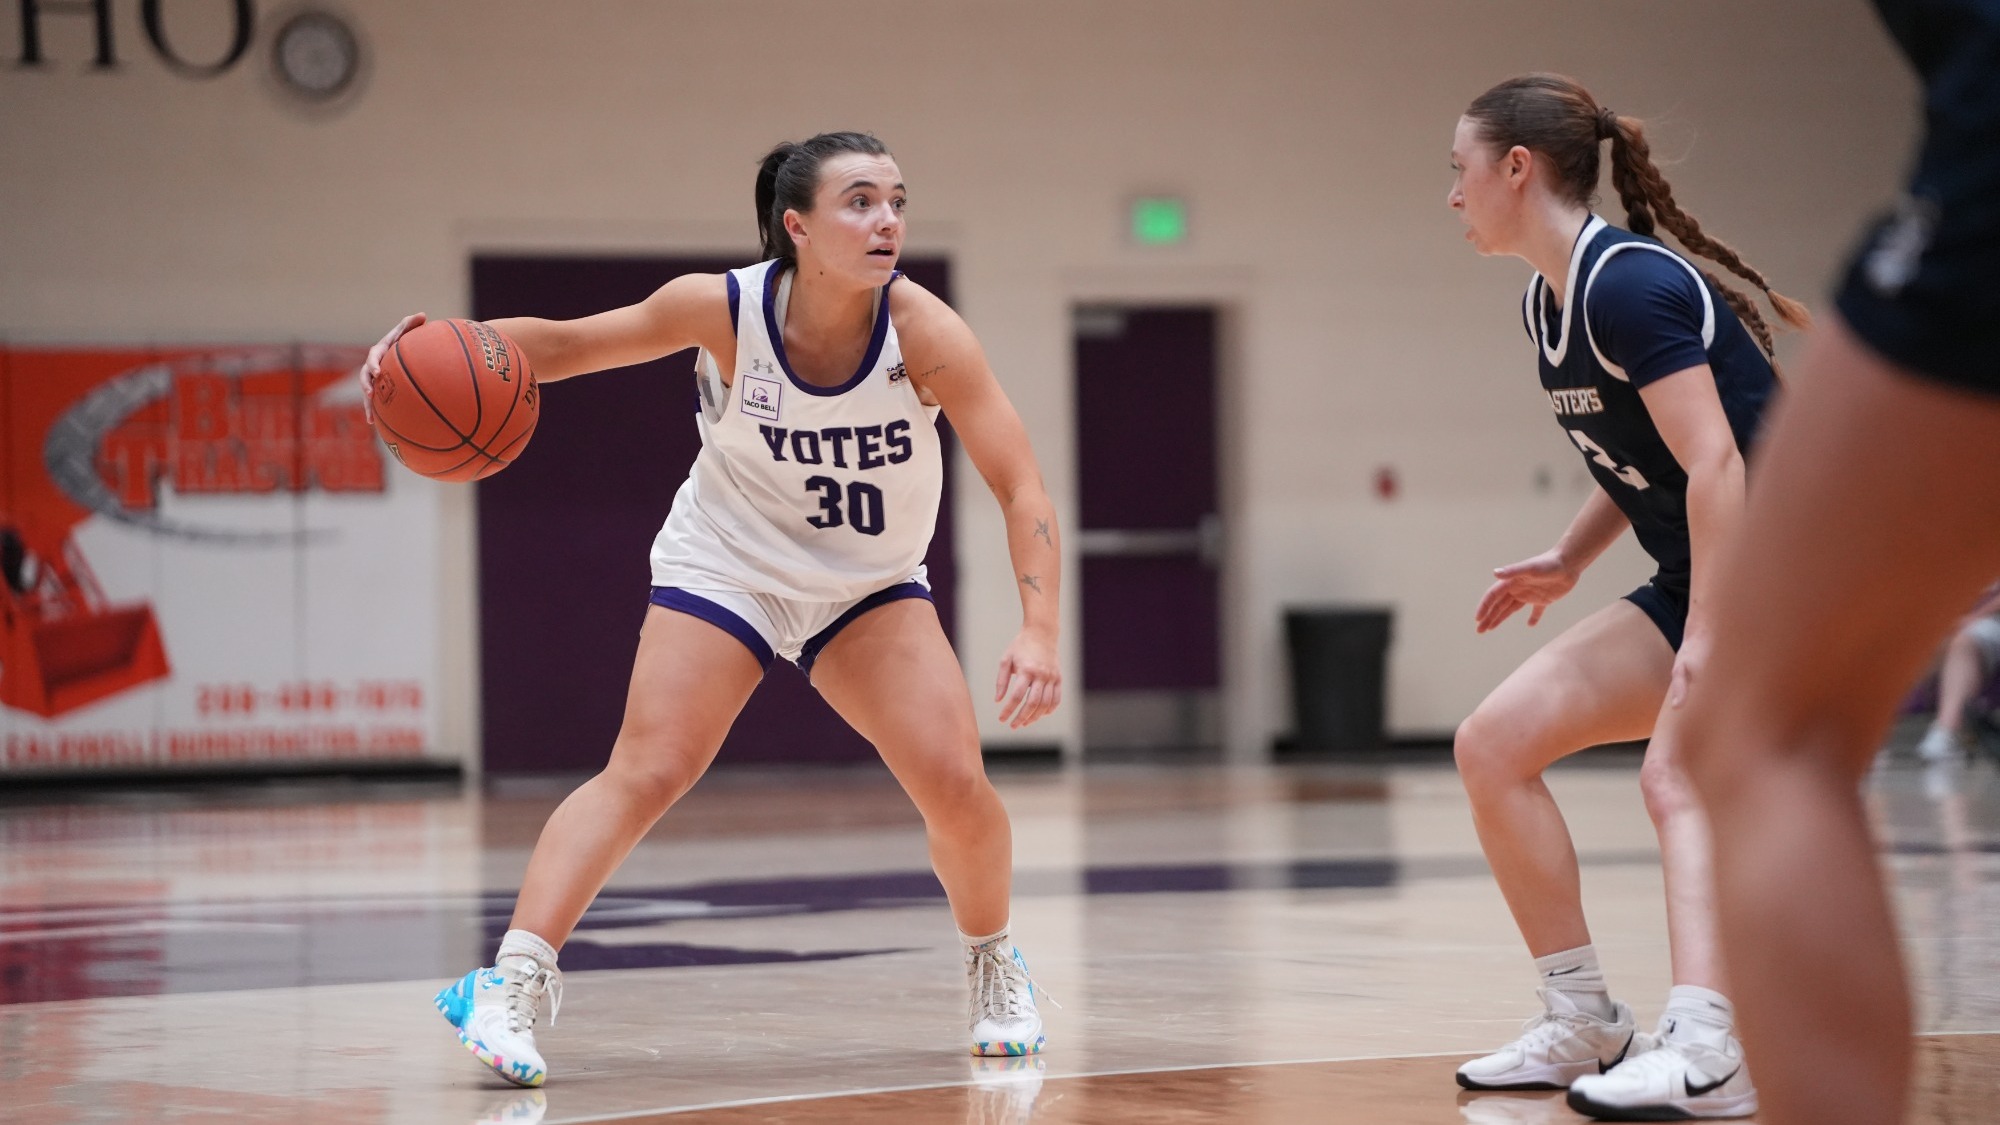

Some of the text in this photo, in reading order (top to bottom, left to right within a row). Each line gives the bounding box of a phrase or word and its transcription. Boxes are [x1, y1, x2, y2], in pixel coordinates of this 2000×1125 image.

[743, 399, 777, 413] TACO BELL
[759, 418, 913, 471] YOTES
[804, 475, 886, 537] 30
